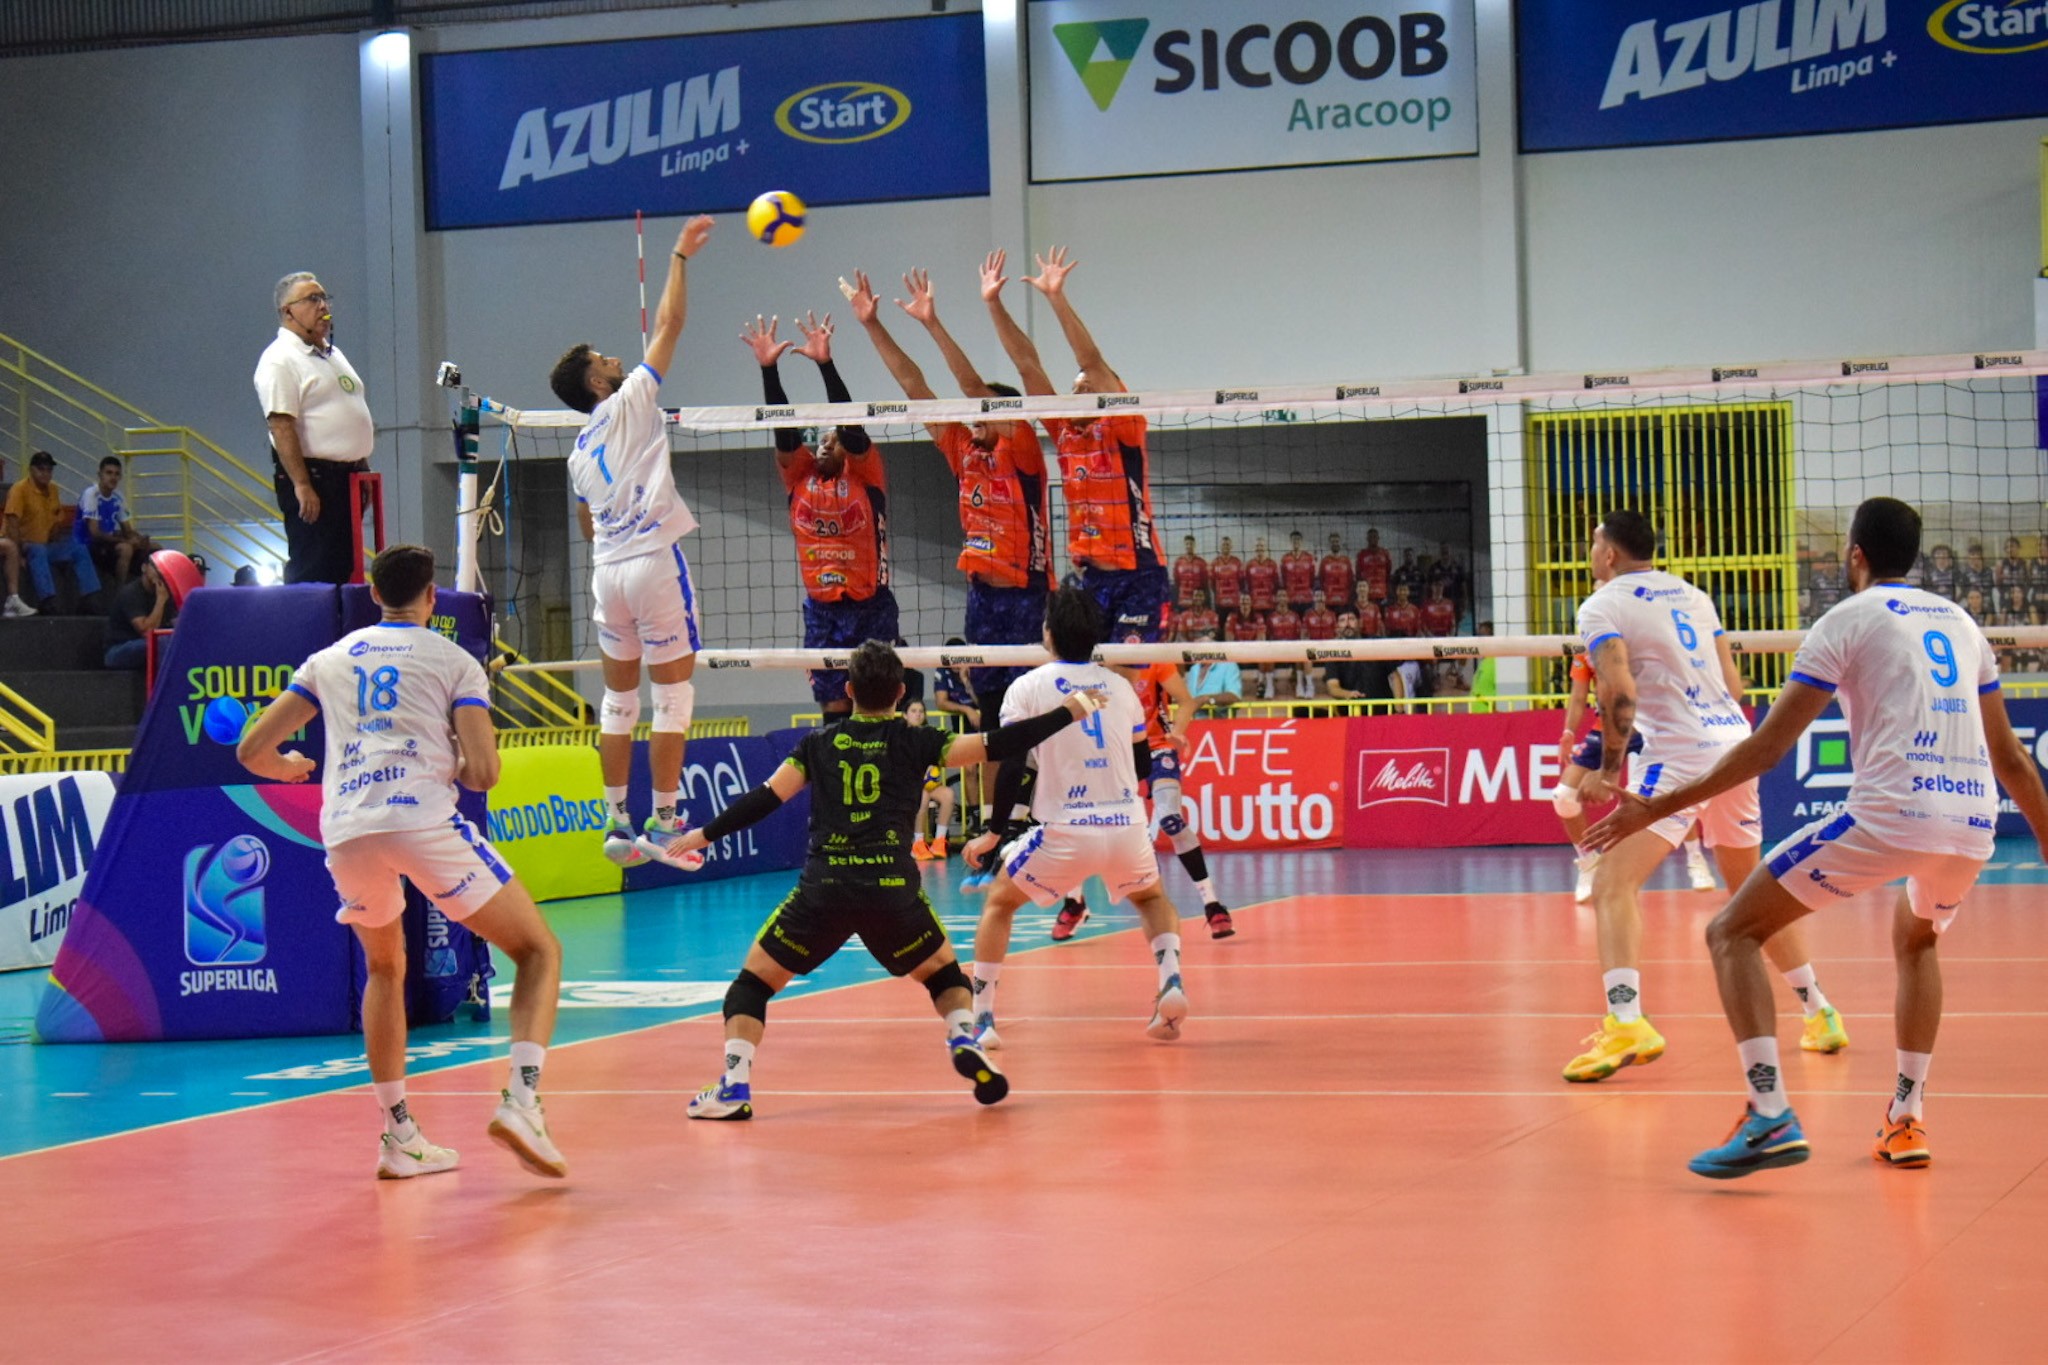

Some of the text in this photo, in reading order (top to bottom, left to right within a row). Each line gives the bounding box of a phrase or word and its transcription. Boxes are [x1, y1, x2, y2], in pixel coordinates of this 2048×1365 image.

[1153, 12, 1449, 94] SICOOB
[1599, 0, 1887, 110] AZULIM
[1790, 58, 1874, 94] Limpa
[799, 93, 887, 132] Start
[1287, 96, 1451, 132] Aracoop
[499, 66, 741, 191] AZULIM
[661, 143, 730, 178] Limpa
[1722, 368, 1759, 380] SUPERLIGA
[1852, 362, 1890, 374] SUPERLIGA
[1985, 355, 2022, 368] SUPERLIGA
[1225, 391, 1259, 402] SUPERLIGA
[1346, 386, 1380, 398] SUPERLIGA
[1468, 381, 1504, 392] SUPERLIGA
[1594, 376, 1630, 388] SUPERLIGA
[764, 408, 795, 419] SUPERLIGA
[876, 404, 908, 415] SUPERLIGA
[990, 399, 1023, 411] SUPERLIGA
[1107, 396, 1140, 407] SUPERLIGA
[971, 484, 984, 508] 6
[815, 518, 839, 536] 20
[1670, 608, 1698, 651] 6
[950, 655, 985, 665] SUPERLIGA
[1191, 652, 1227, 662] SUPERLIGA
[1316, 649, 1353, 660] SUPERLIGA
[1443, 646, 1480, 657] SUPERLIGA
[1923, 630, 1959, 688] 9
[187, 665, 246, 700] SOU
[353, 665, 400, 717] 18
[1931, 697, 1968, 715] JAQUES
[1080, 708, 1104, 749] 4
[1179, 719, 1297, 777] AFÉ
[1906, 751, 1946, 765] motiva
[338, 765, 406, 797] selbetti
[678, 742, 751, 823] nel
[838, 760, 880, 805] 10
[1369, 758, 1436, 792] Melitta
[1912, 774, 1985, 798] selbetti
[488, 807, 525, 842] NCO
[1181, 782, 1334, 841] olutto
[1793, 803, 1807, 816] A
[0, 775, 96, 909] LIM
[706, 829, 759, 861] ASIL
[30, 898, 77, 942] Lim
[180, 968, 278, 996] SUPERLIGA
